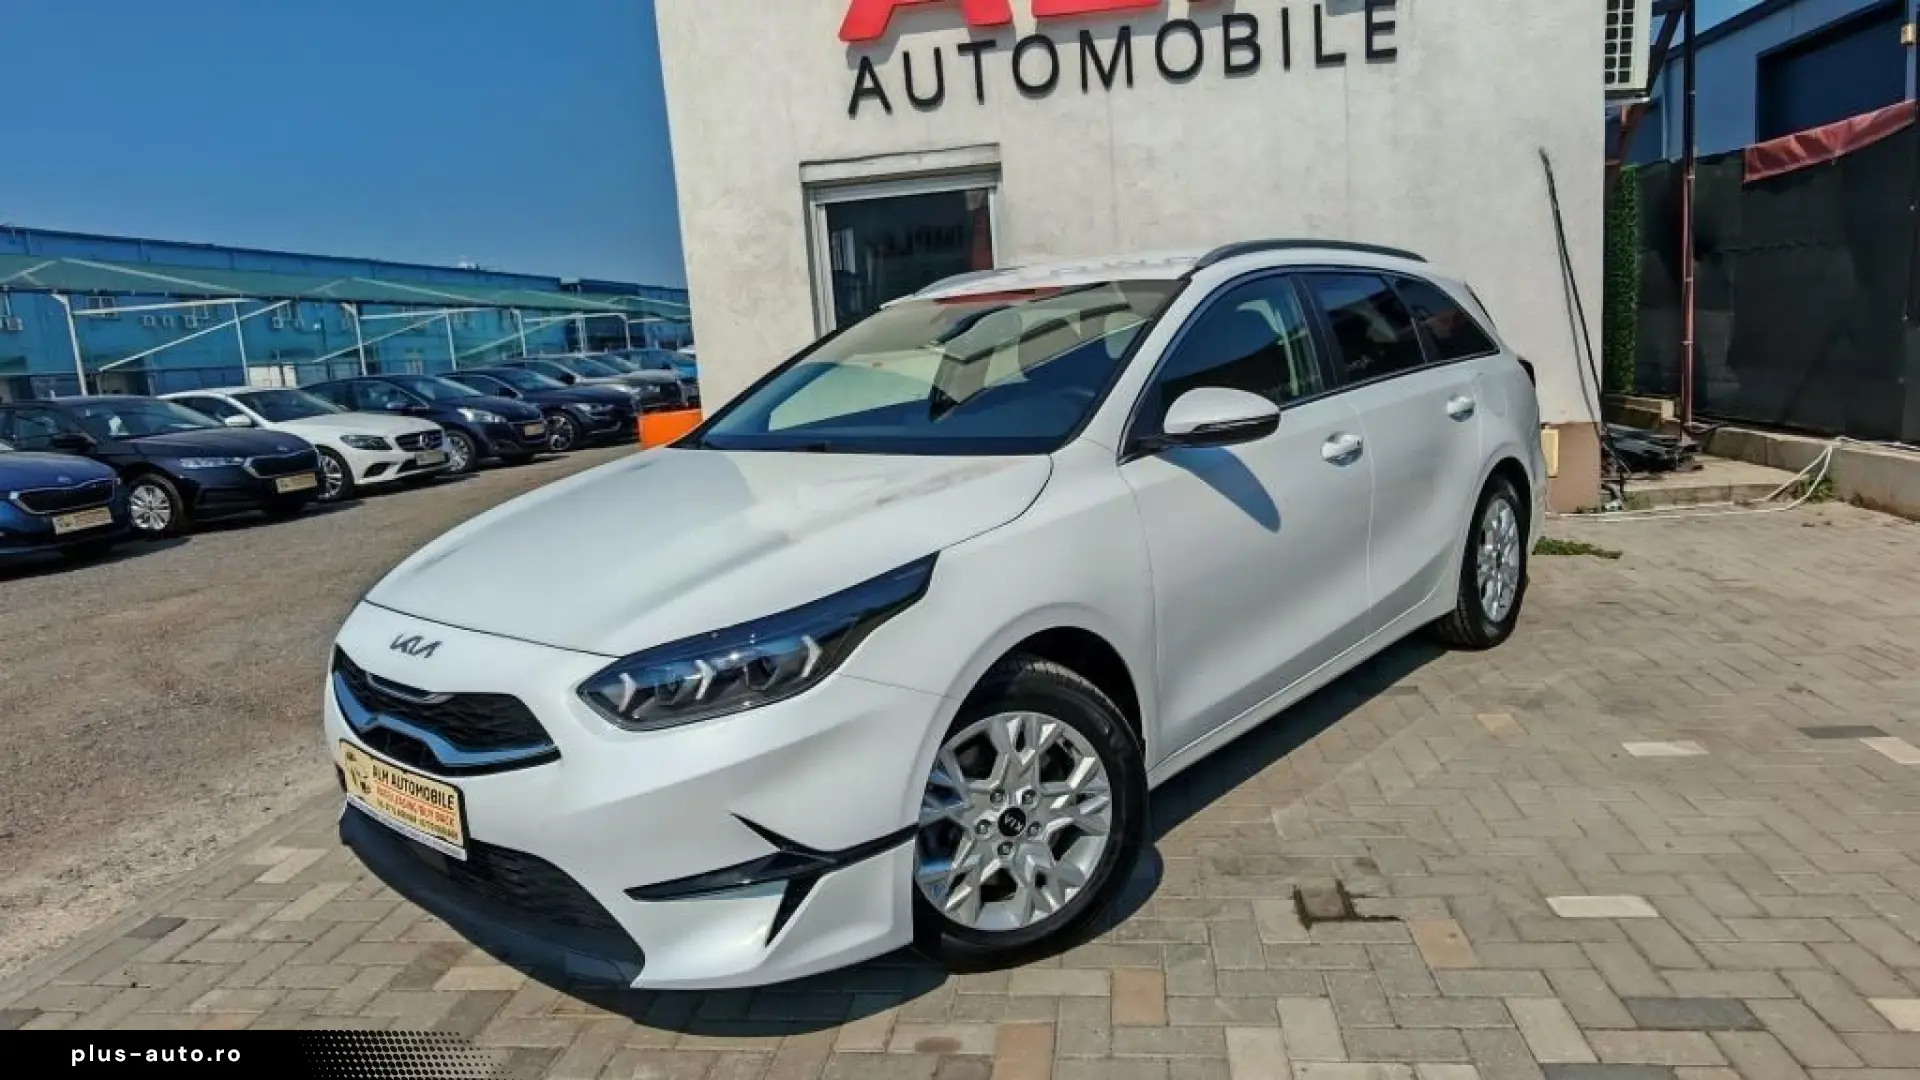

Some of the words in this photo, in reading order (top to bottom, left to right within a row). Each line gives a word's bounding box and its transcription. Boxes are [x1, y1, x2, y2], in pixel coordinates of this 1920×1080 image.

[848, 1, 1397, 119] AUTOMOBILE
[389, 634, 442, 659] KIA
[391, 773, 454, 810] AUTOMOBILE
